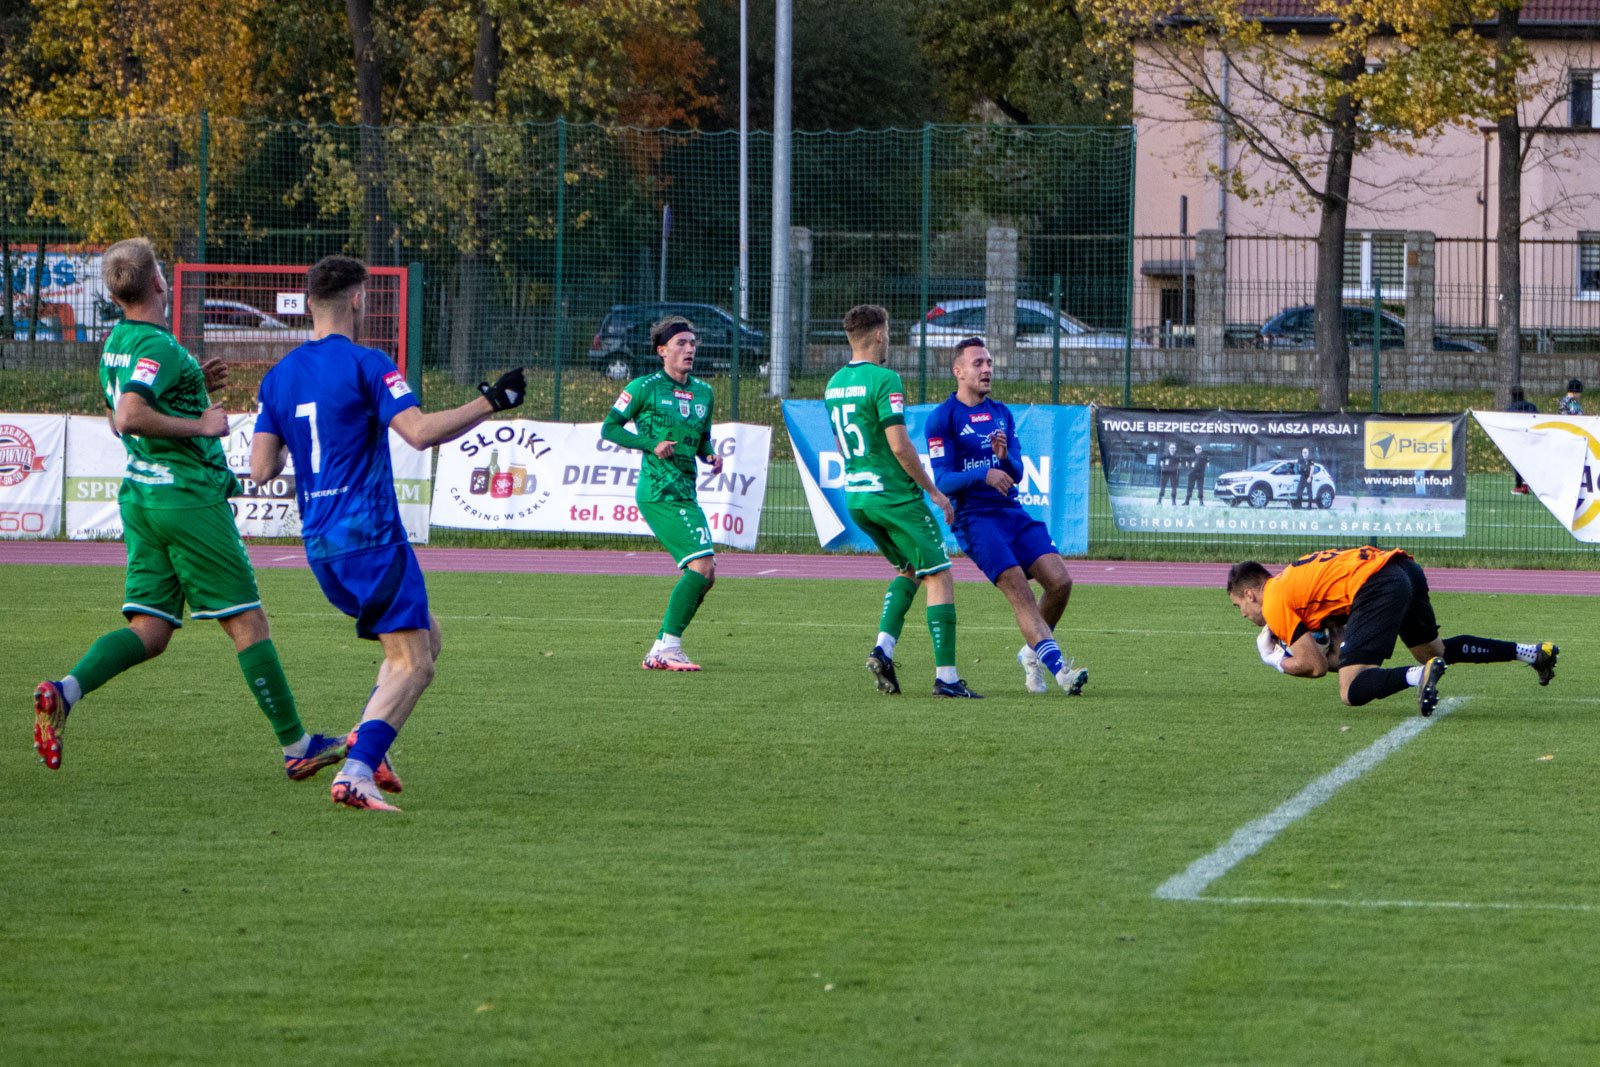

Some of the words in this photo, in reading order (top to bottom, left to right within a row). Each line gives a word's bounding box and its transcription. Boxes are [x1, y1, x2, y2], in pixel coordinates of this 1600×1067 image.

[284, 299, 297, 309] F5
[831, 403, 866, 460] 15
[1102, 420, 1144, 432] TWOJE
[1148, 420, 1259, 434] BEZPIECZEŃSTWO
[1268, 423, 1310, 435] NASZA
[1312, 424, 1351, 435] PASJA
[295, 401, 321, 474] 7
[459, 426, 552, 460] SŁOIKI
[1399, 437, 1448, 454] Piast
[1364, 476, 1453, 487] www.piast.info.pl
[246, 503, 289, 520] 227
[450, 487, 500, 521] CATERING
[518, 490, 550, 518] SZKLE
[569, 505, 604, 521] tel.
[612, 504, 647, 523] 88
[709, 512, 744, 535] 100
[1118, 518, 1194, 528] OCHRONA
[1215, 519, 1319, 531] MONITORING
[1340, 521, 1441, 534] SPRZĄTANIE
